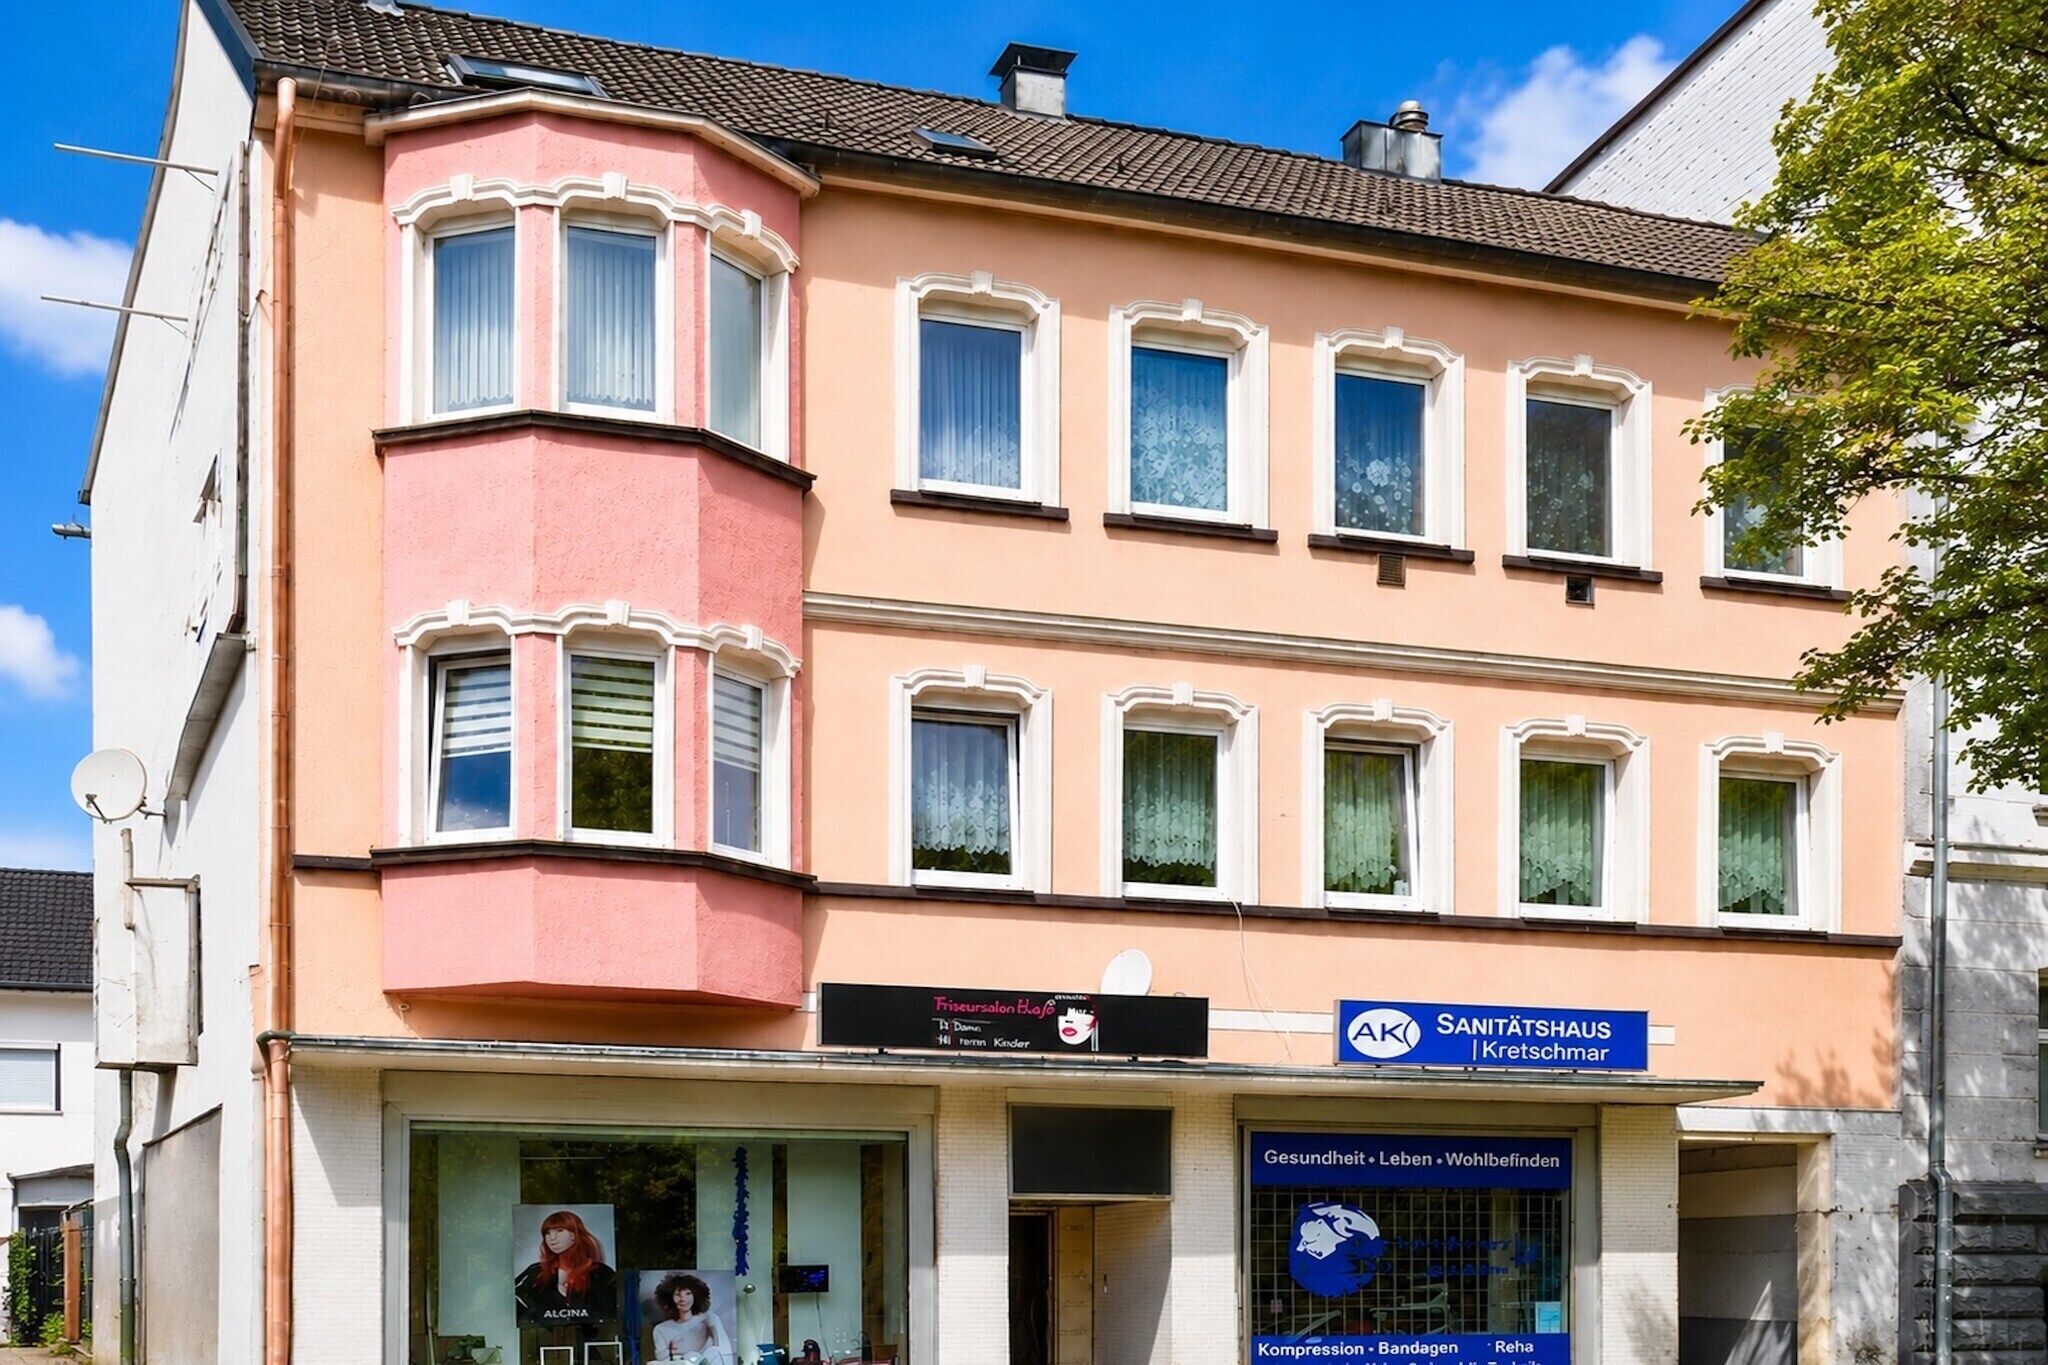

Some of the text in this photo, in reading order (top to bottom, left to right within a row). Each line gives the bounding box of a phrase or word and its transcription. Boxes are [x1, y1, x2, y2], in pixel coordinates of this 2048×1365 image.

[1482, 1040, 1609, 1062] Kretschmar
[1264, 1149, 1560, 1168] Gesundheit Leben Wohlbefinden
[544, 1309, 589, 1318] ALCINA
[1258, 1340, 1534, 1360] Kompression Bandagen Reha
